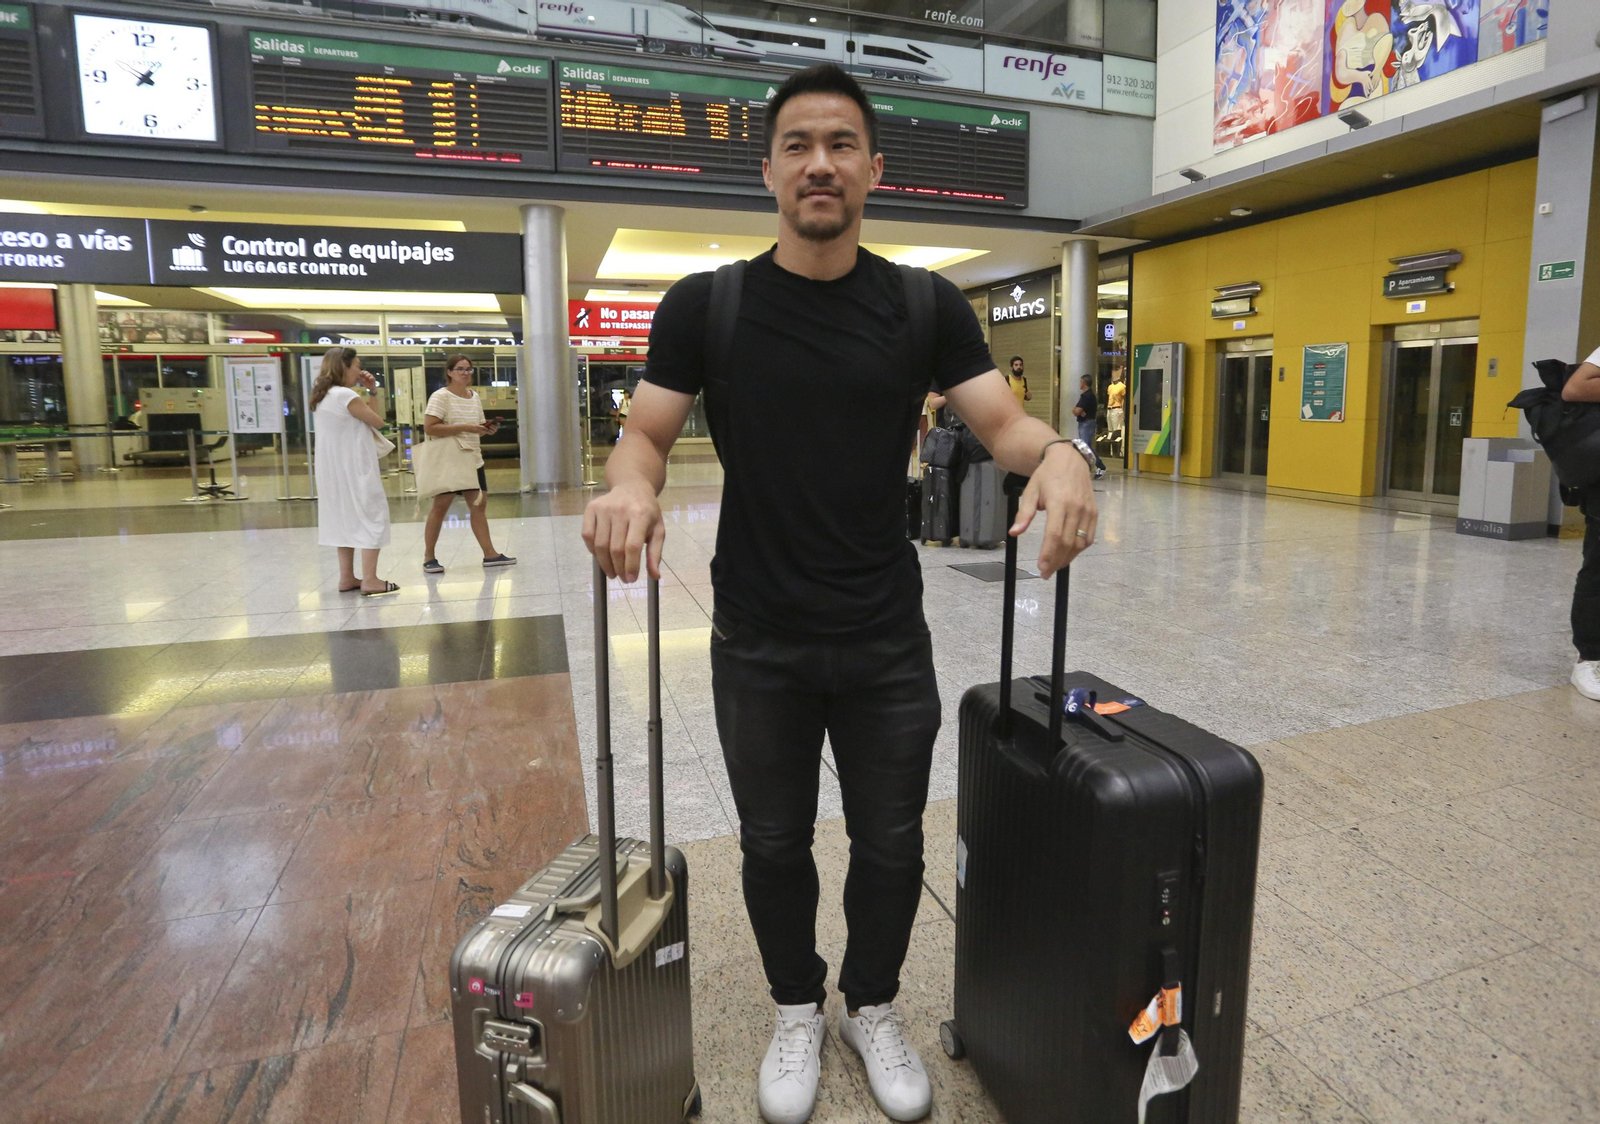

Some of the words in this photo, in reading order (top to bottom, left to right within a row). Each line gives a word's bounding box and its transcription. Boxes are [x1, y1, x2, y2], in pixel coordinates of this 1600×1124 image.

[539, 2, 584, 15] renfe
[925, 9, 984, 28] renfe.com
[131, 32, 155, 48] 12
[254, 37, 305, 54] Salidas
[313, 47, 359, 58] DEPARTURES
[512, 64, 542, 75] adif
[1003, 53, 1067, 81] renfe
[93, 69, 107, 83] 9
[186, 77, 199, 90] 3
[563, 67, 605, 81] Salidas
[612, 75, 650, 85] DEPARTURES
[1107, 74, 1121, 86] 912
[1124, 77, 1138, 88] 320
[1140, 80, 1154, 91] 320
[1051, 84, 1085, 100] AVE
[1106, 87, 1154, 100] www.renfe.com
[143, 113, 157, 127] 6
[1001, 118, 1022, 126] adif
[56, 233, 73, 249] a
[78, 228, 133, 251] vías
[222, 235, 306, 257] Control
[313, 238, 342, 258] de
[348, 240, 455, 265] equipajes
[223, 260, 298, 274] LUGGAGE
[300, 262, 368, 277] CONTROL
[1389, 280, 1396, 291] P
[1398, 276, 1435, 286] Aparcamiento
[600, 307, 617, 319] No
[621, 310, 655, 321] pasar
[993, 298, 1045, 321] BAILEYS
[1473, 523, 1503, 534] vialia
